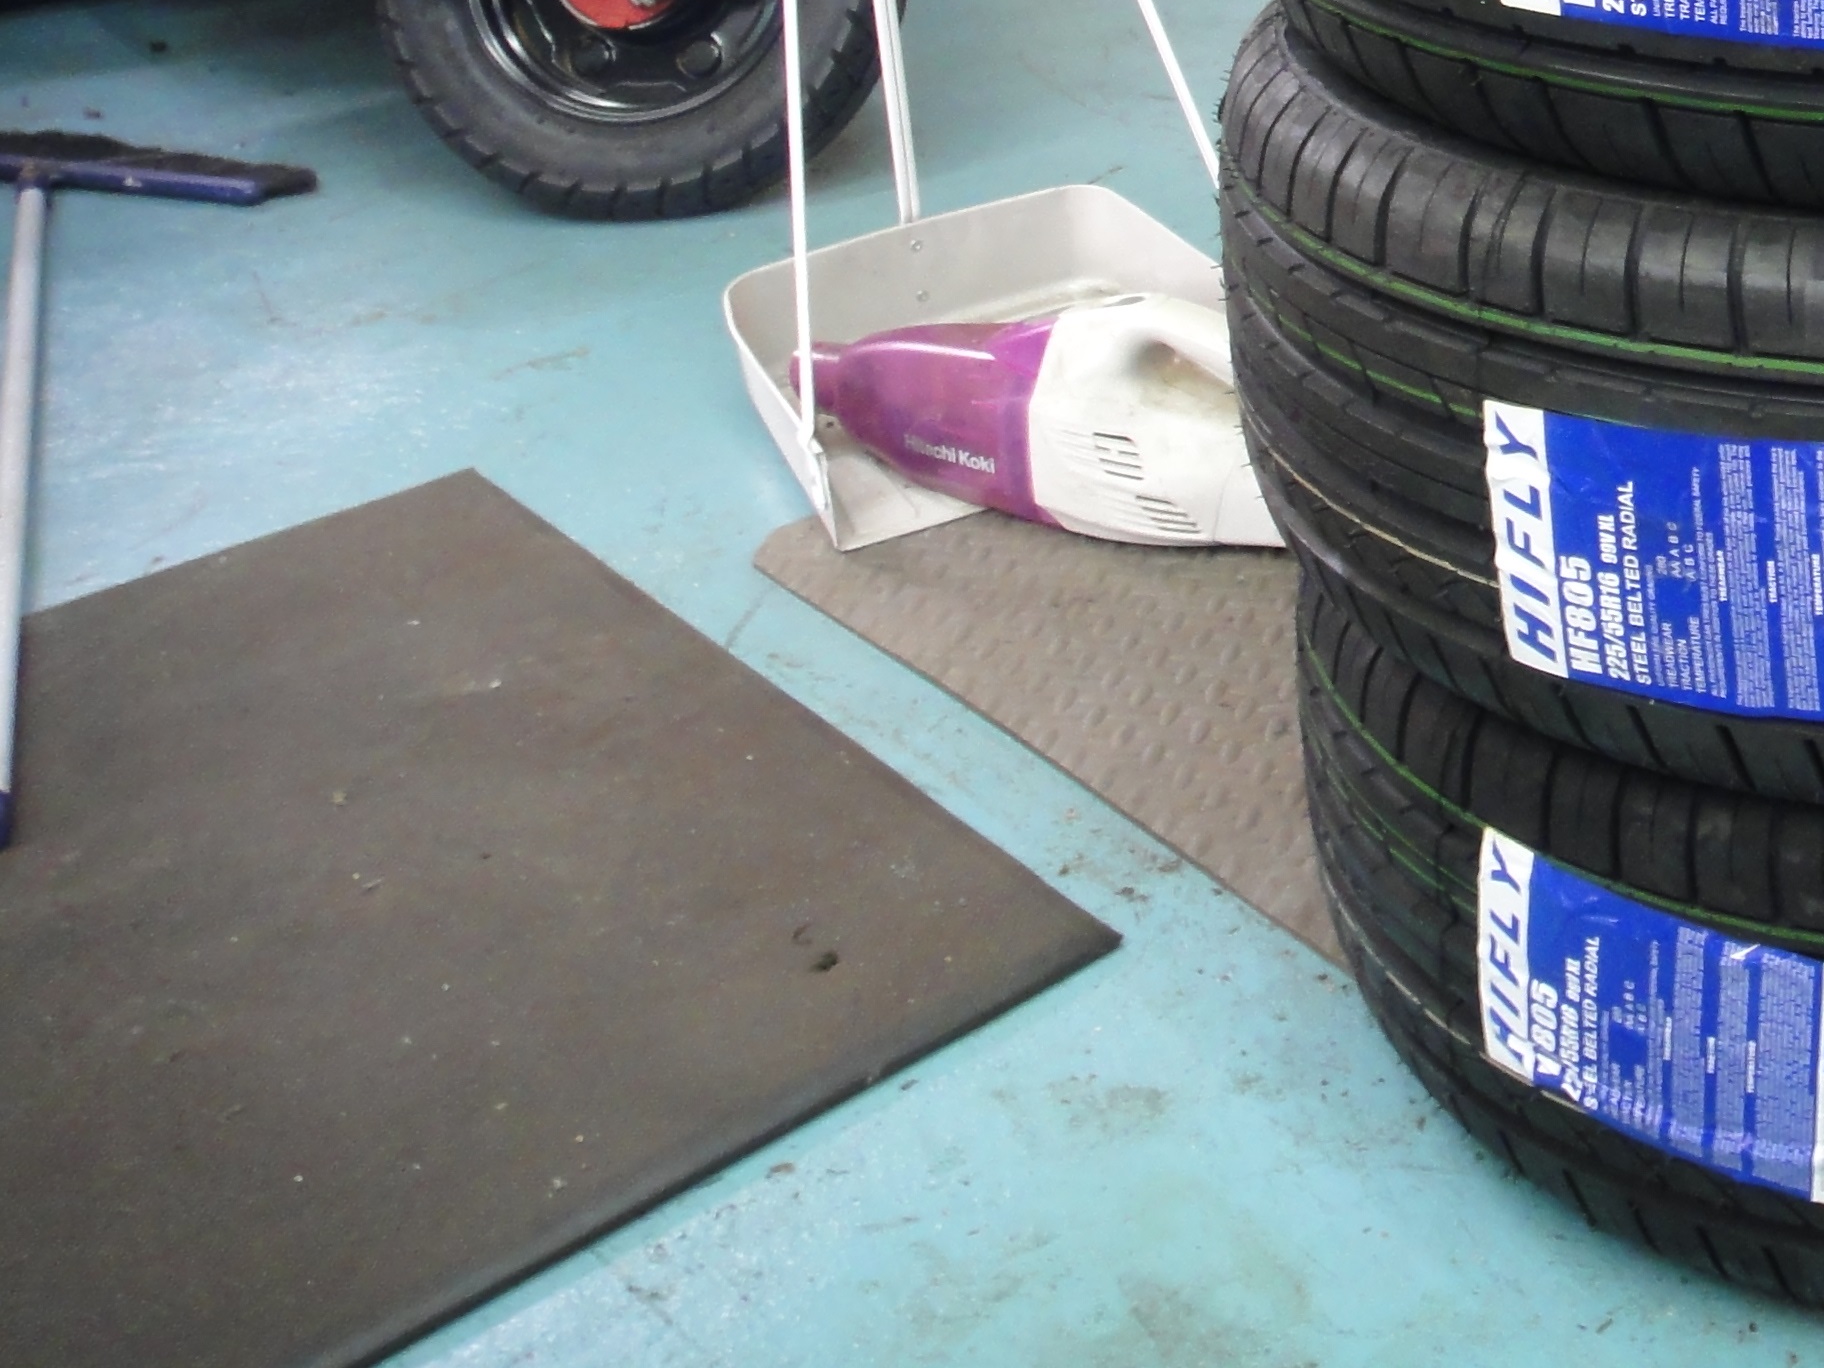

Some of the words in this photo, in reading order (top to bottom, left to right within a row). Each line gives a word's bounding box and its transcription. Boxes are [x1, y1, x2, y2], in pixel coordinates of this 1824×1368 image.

[1496, 411, 1558, 664] HIFLY
[1616, 480, 1639, 551] RADIAL
[1559, 555, 1603, 675] HF805
[1597, 572, 1631, 681] 225/55R16
[1622, 554, 1646, 627] BELTED
[1630, 631, 1653, 685] STEEL
[1686, 616, 1707, 694] TEMPERATURE
[1583, 936, 1600, 998] RADIAL
